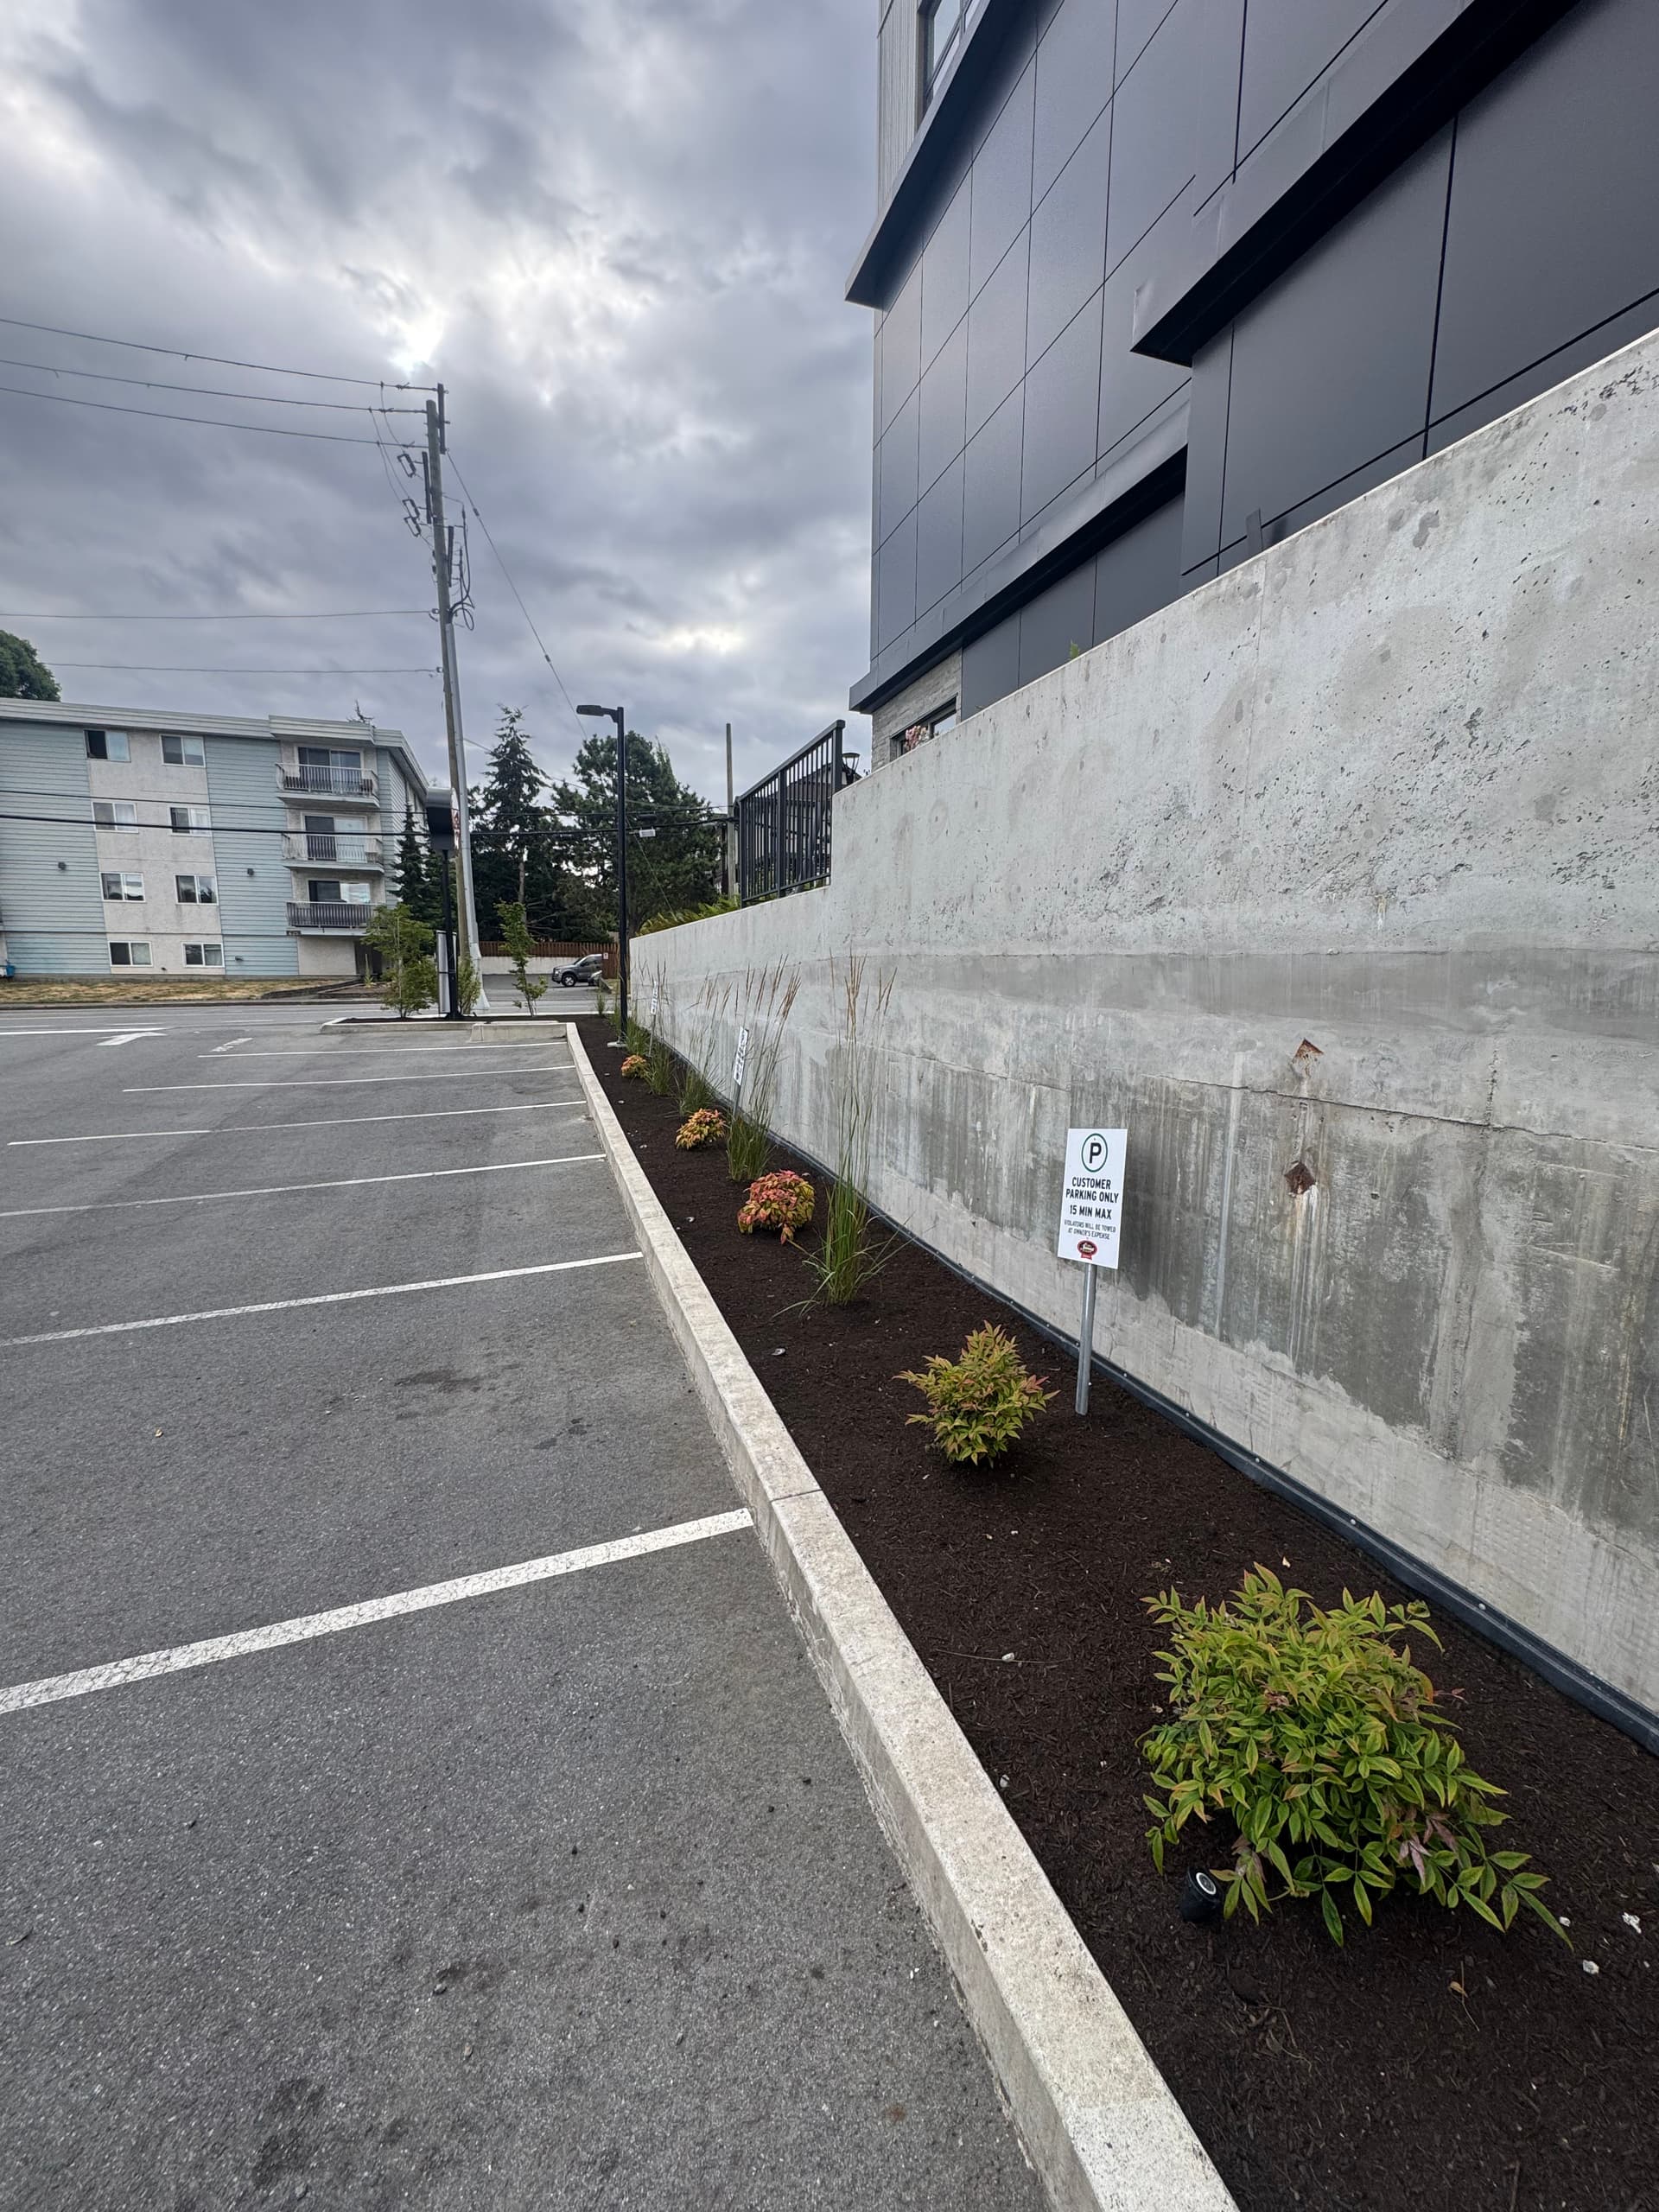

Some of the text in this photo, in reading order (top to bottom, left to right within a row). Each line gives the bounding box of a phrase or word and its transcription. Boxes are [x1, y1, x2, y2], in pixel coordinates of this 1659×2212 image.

[1089, 1142, 1102, 1164] P
[1071, 1177, 1111, 1190] CUSTOMER
[1065, 1188, 1119, 1204] PARKING ONLY
[1070, 1205, 1112, 1220] 15 MIN MAX
